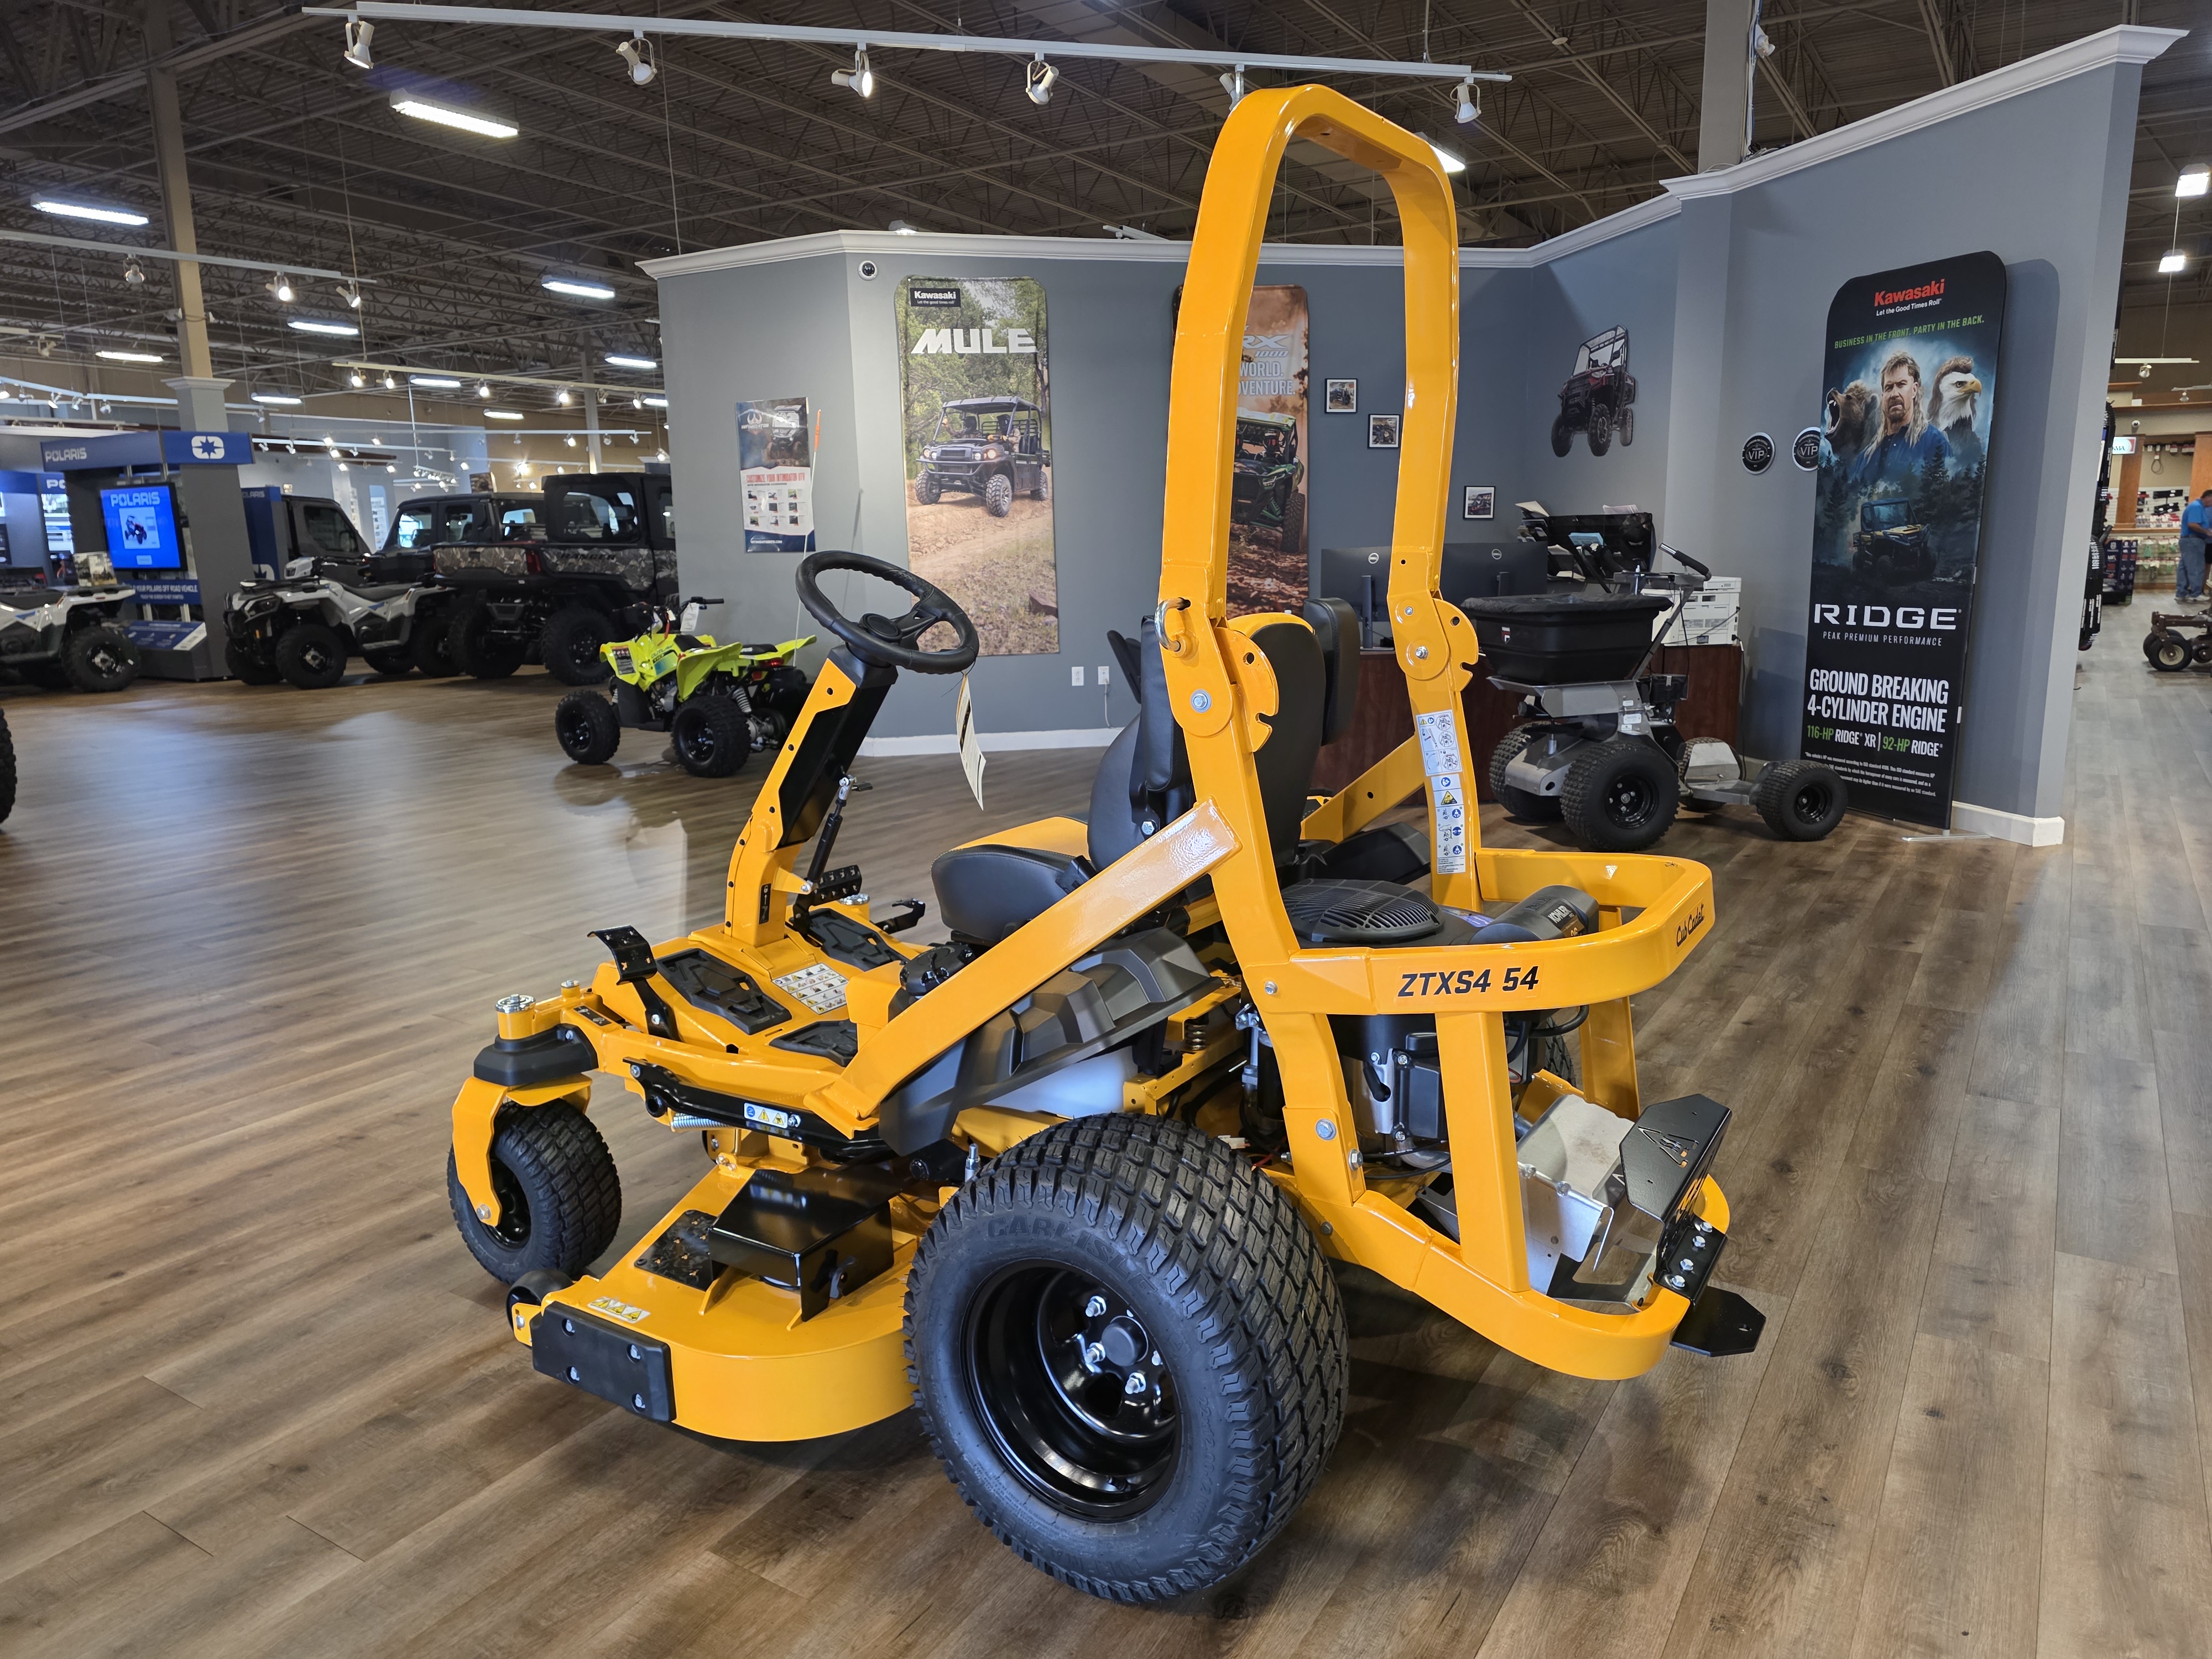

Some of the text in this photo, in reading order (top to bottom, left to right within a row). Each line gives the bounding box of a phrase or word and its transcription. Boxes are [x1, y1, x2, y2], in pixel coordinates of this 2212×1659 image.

[914, 291, 956, 299] Kawasaki
[1874, 278, 1945, 306] Kawasaki
[1896, 303, 1911, 312] Good
[1911, 301, 1928, 310] Times
[911, 328, 1038, 354] MULE
[1834, 315, 1985, 349] BUSINESS IN THE FRONT. PARTY IN THE BACK.
[1240, 362, 1284, 377] WORLD.
[1238, 380, 1296, 395] VENTURE.
[45, 447, 87, 463] POLARIS
[1748, 450, 1765, 460] VIP
[1801, 446, 1818, 456] VIP
[110, 491, 160, 507] POLARIS
[1814, 603, 1957, 630] RIDGE
[1823, 631, 1942, 646] PEAK PREMIUM PERFORMANCE
[1810, 668, 1949, 705] GROUND BREAKING
[1807, 694, 1948, 733] 4-CYLINDER ENGINE
[1807, 724, 1939, 757] 116-HP RIDGE XR 92-HP RIDGE
[1547, 905, 1571, 924] KOHLER
[1676, 902, 1705, 947] Cub Cadet
[1397, 966, 1539, 998] ZTXS4 54
[988, 1214, 1158, 1300] CARLISLE
